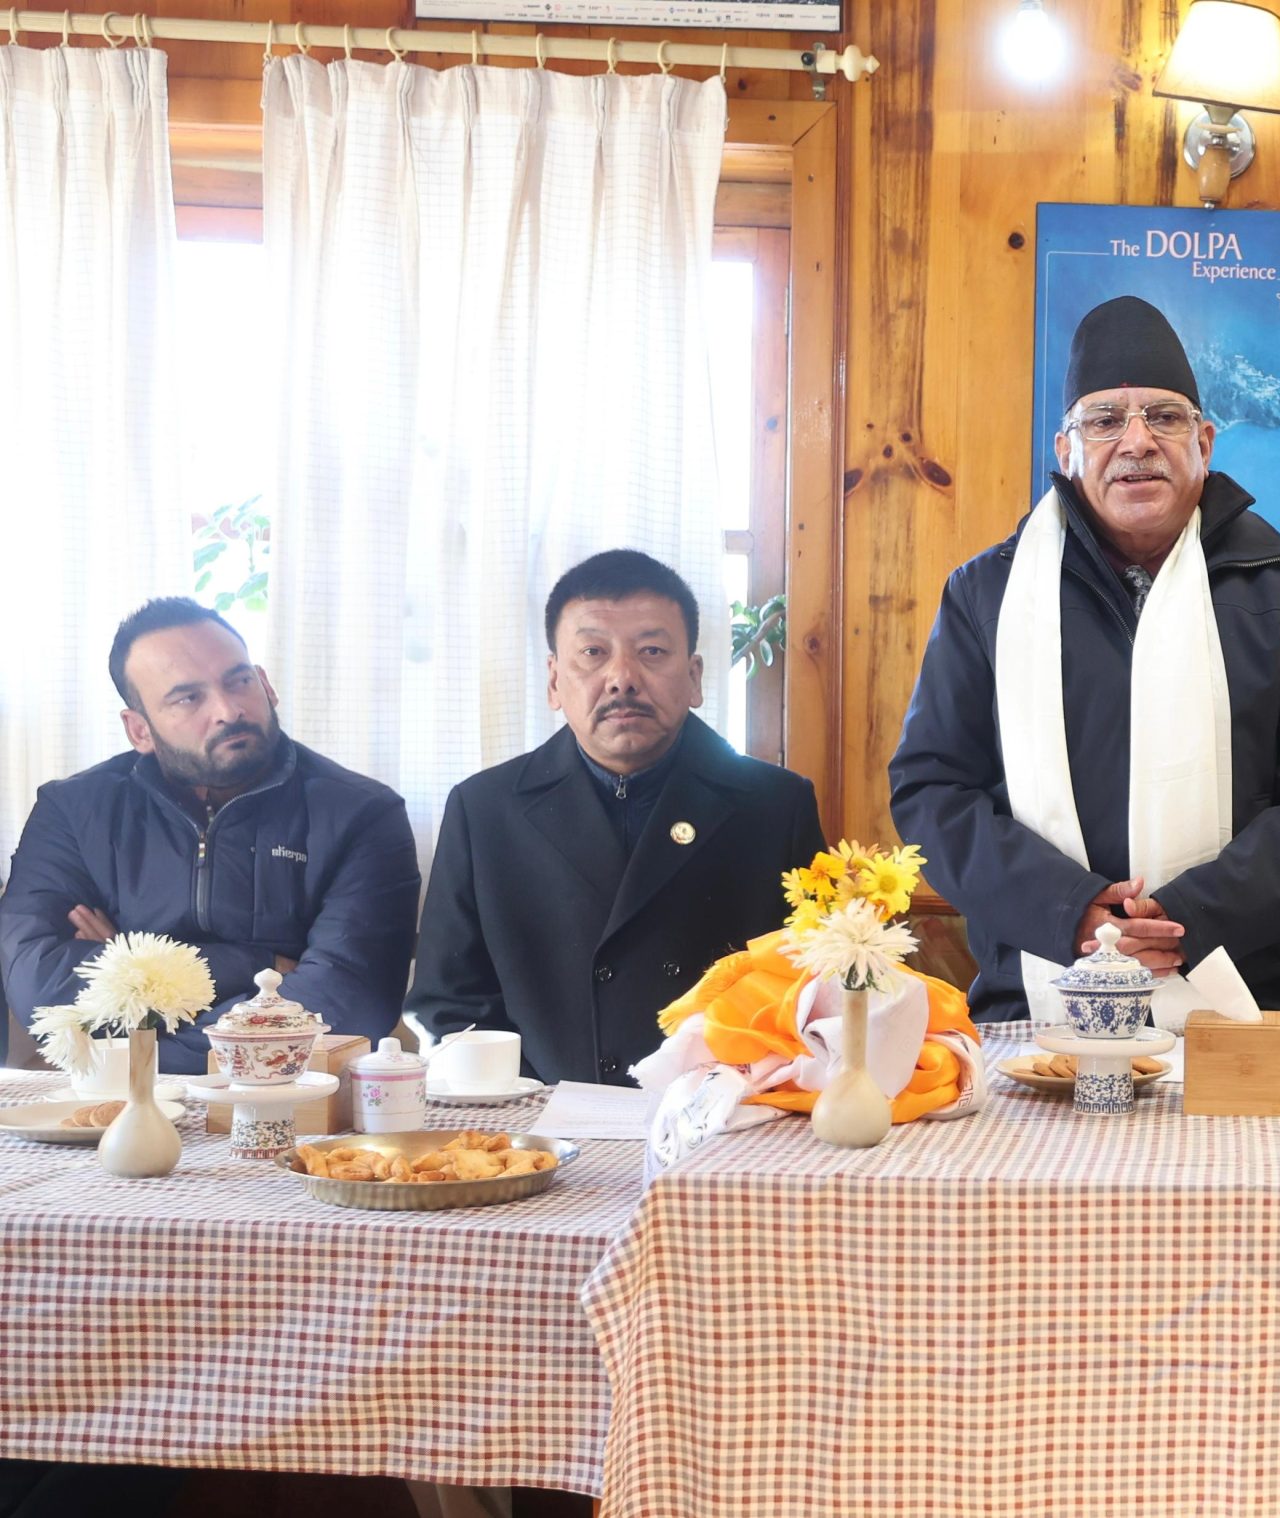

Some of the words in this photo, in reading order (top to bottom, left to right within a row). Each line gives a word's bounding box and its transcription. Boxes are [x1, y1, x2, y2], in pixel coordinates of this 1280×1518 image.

[1110, 239, 1140, 257] The
[1146, 230, 1242, 260] DOLPA
[1192, 261, 1276, 283] Experience
